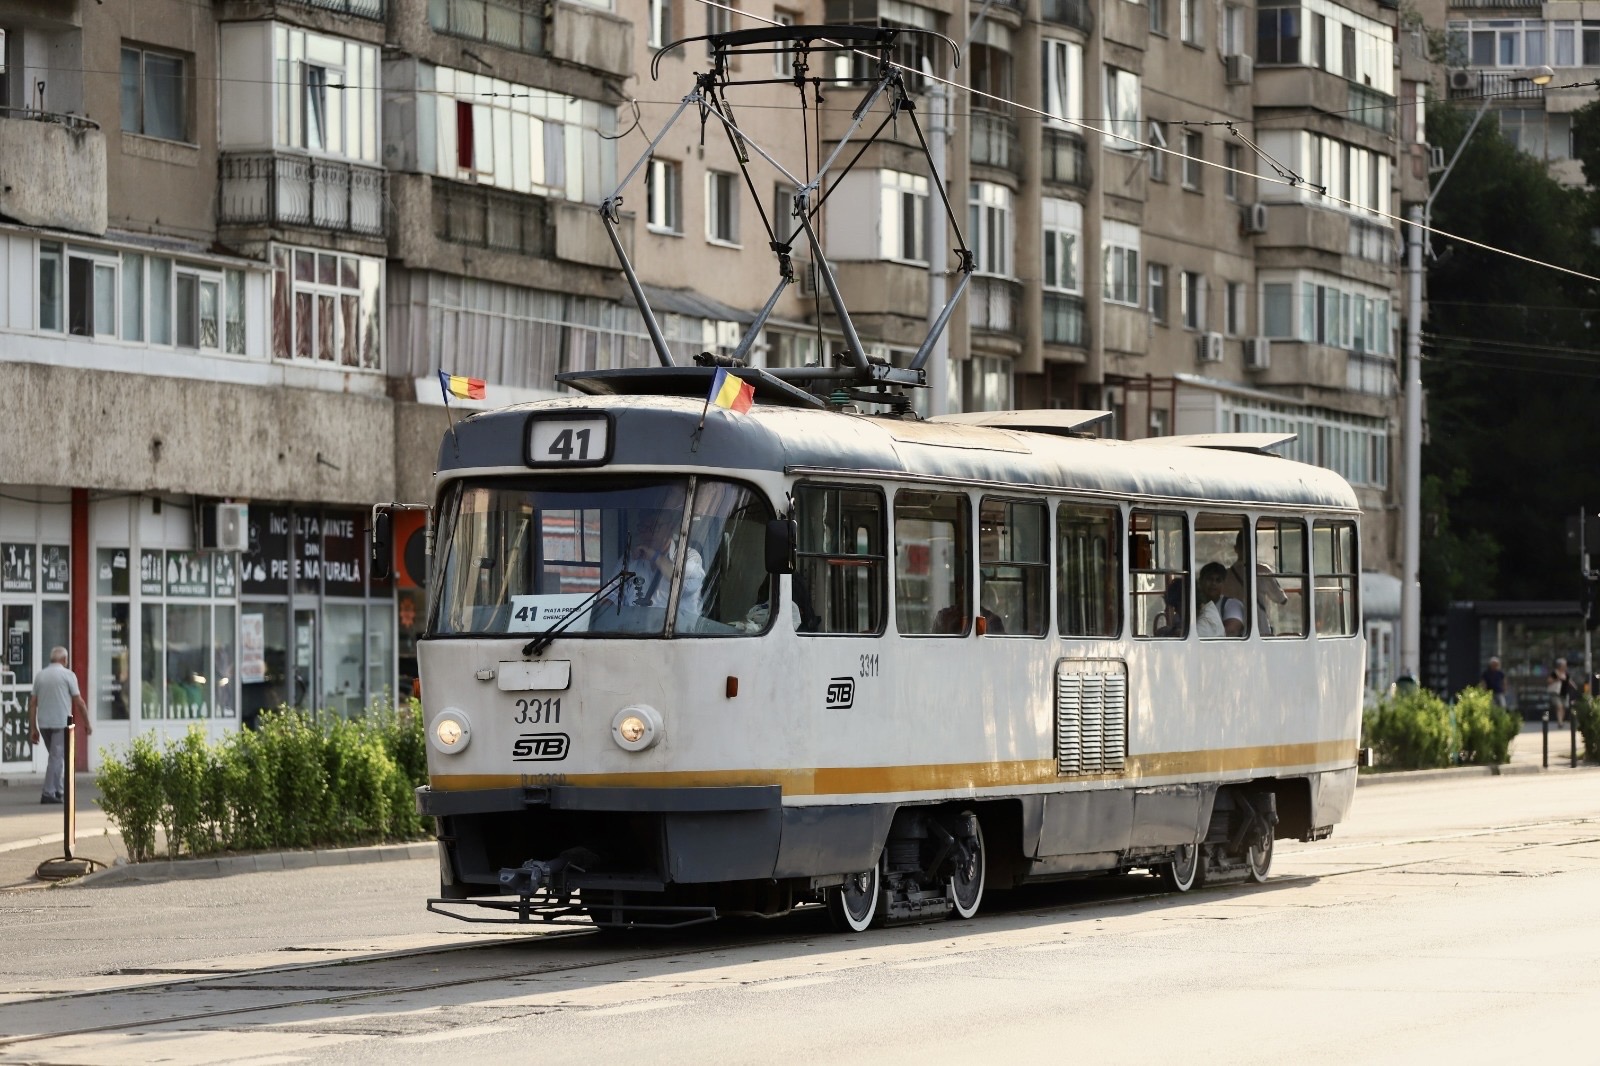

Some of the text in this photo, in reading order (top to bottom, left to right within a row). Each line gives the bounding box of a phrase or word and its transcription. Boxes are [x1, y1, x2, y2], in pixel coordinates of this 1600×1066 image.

[548, 428, 591, 460] 41
[304, 542, 319, 556] DIN
[271, 559, 302, 580] PIEE
[514, 606, 538, 621] 41
[860, 653, 879, 677] 3311
[826, 682, 852, 703] STB
[514, 698, 561, 724] 3311
[512, 738, 565, 756] STB
